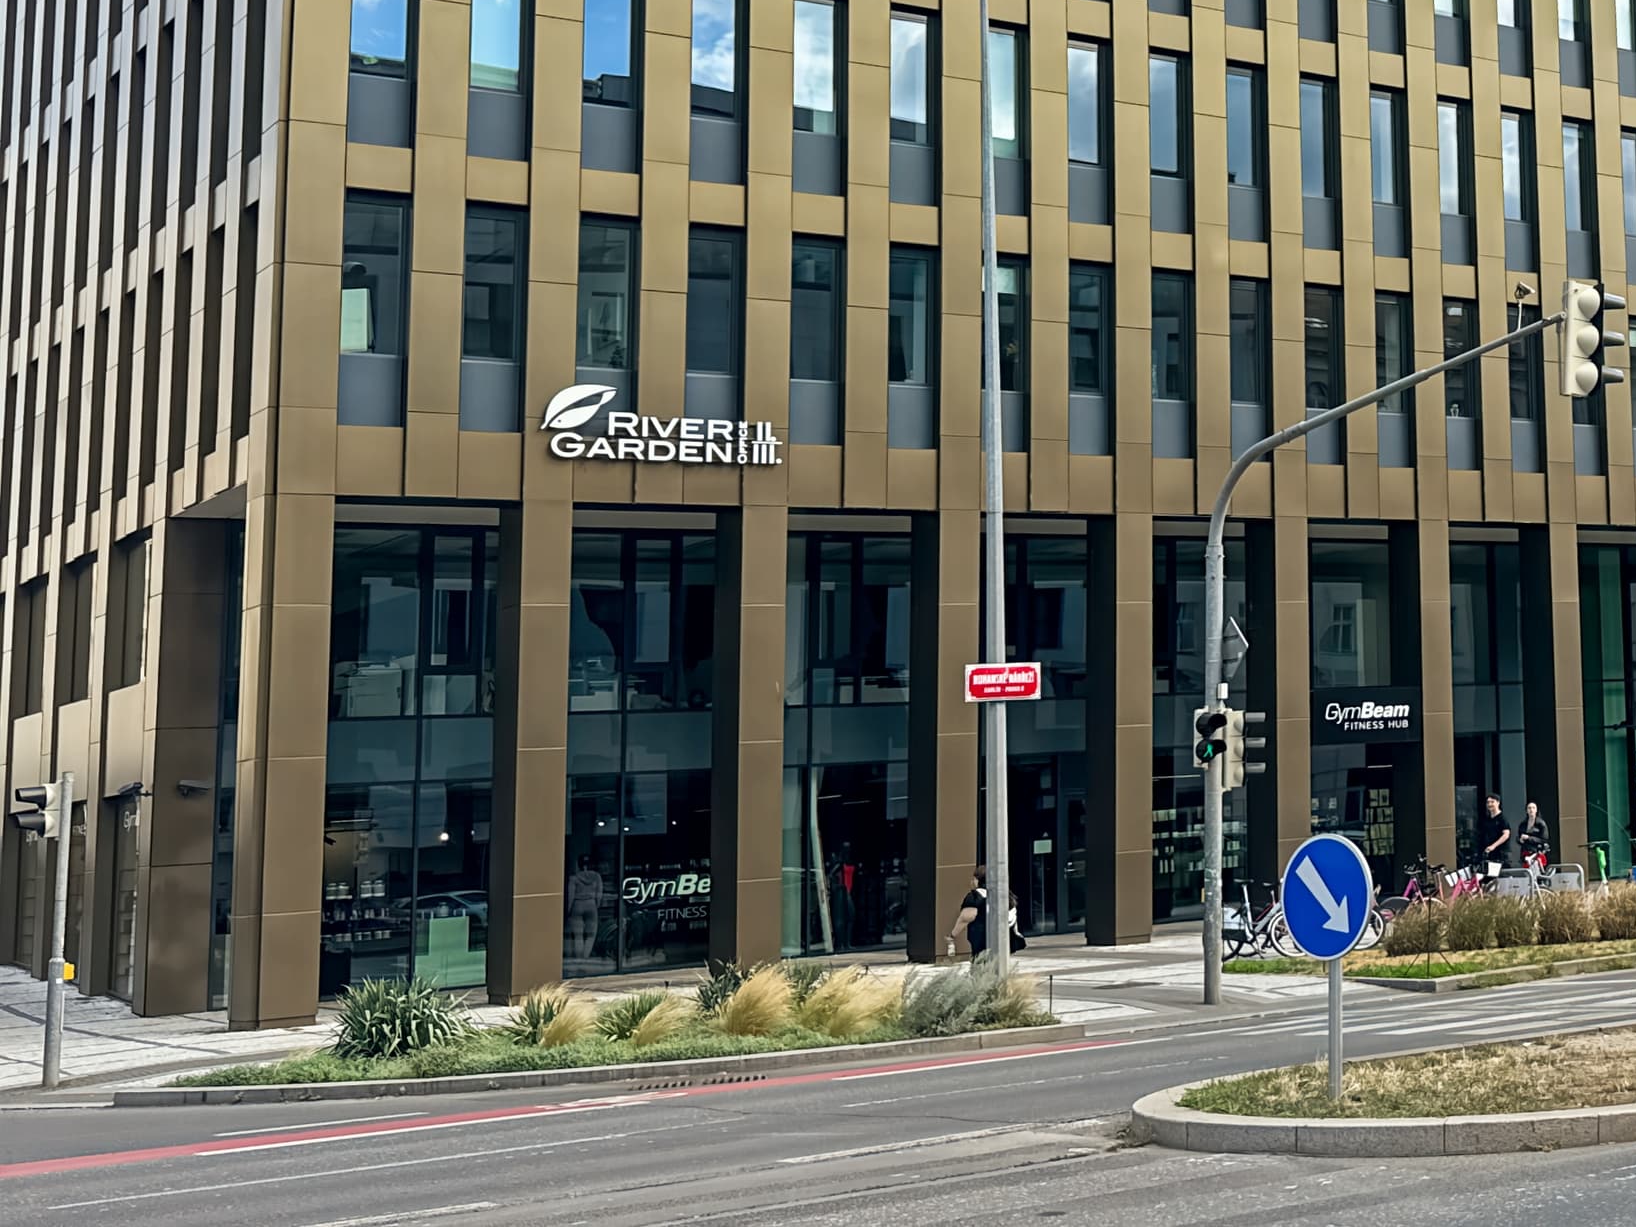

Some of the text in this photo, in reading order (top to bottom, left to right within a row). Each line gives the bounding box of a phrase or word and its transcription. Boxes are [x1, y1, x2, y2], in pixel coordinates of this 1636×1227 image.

[608, 411, 733, 440] RIVER
[550, 432, 732, 463] GARDEN
[737, 420, 748, 464] OFFICE
[1325, 701, 1410, 724] GymBeam
[1344, 719, 1409, 731] FITNESS HUB
[622, 873, 711, 904] GymBe
[657, 905, 708, 920] FITNESS
